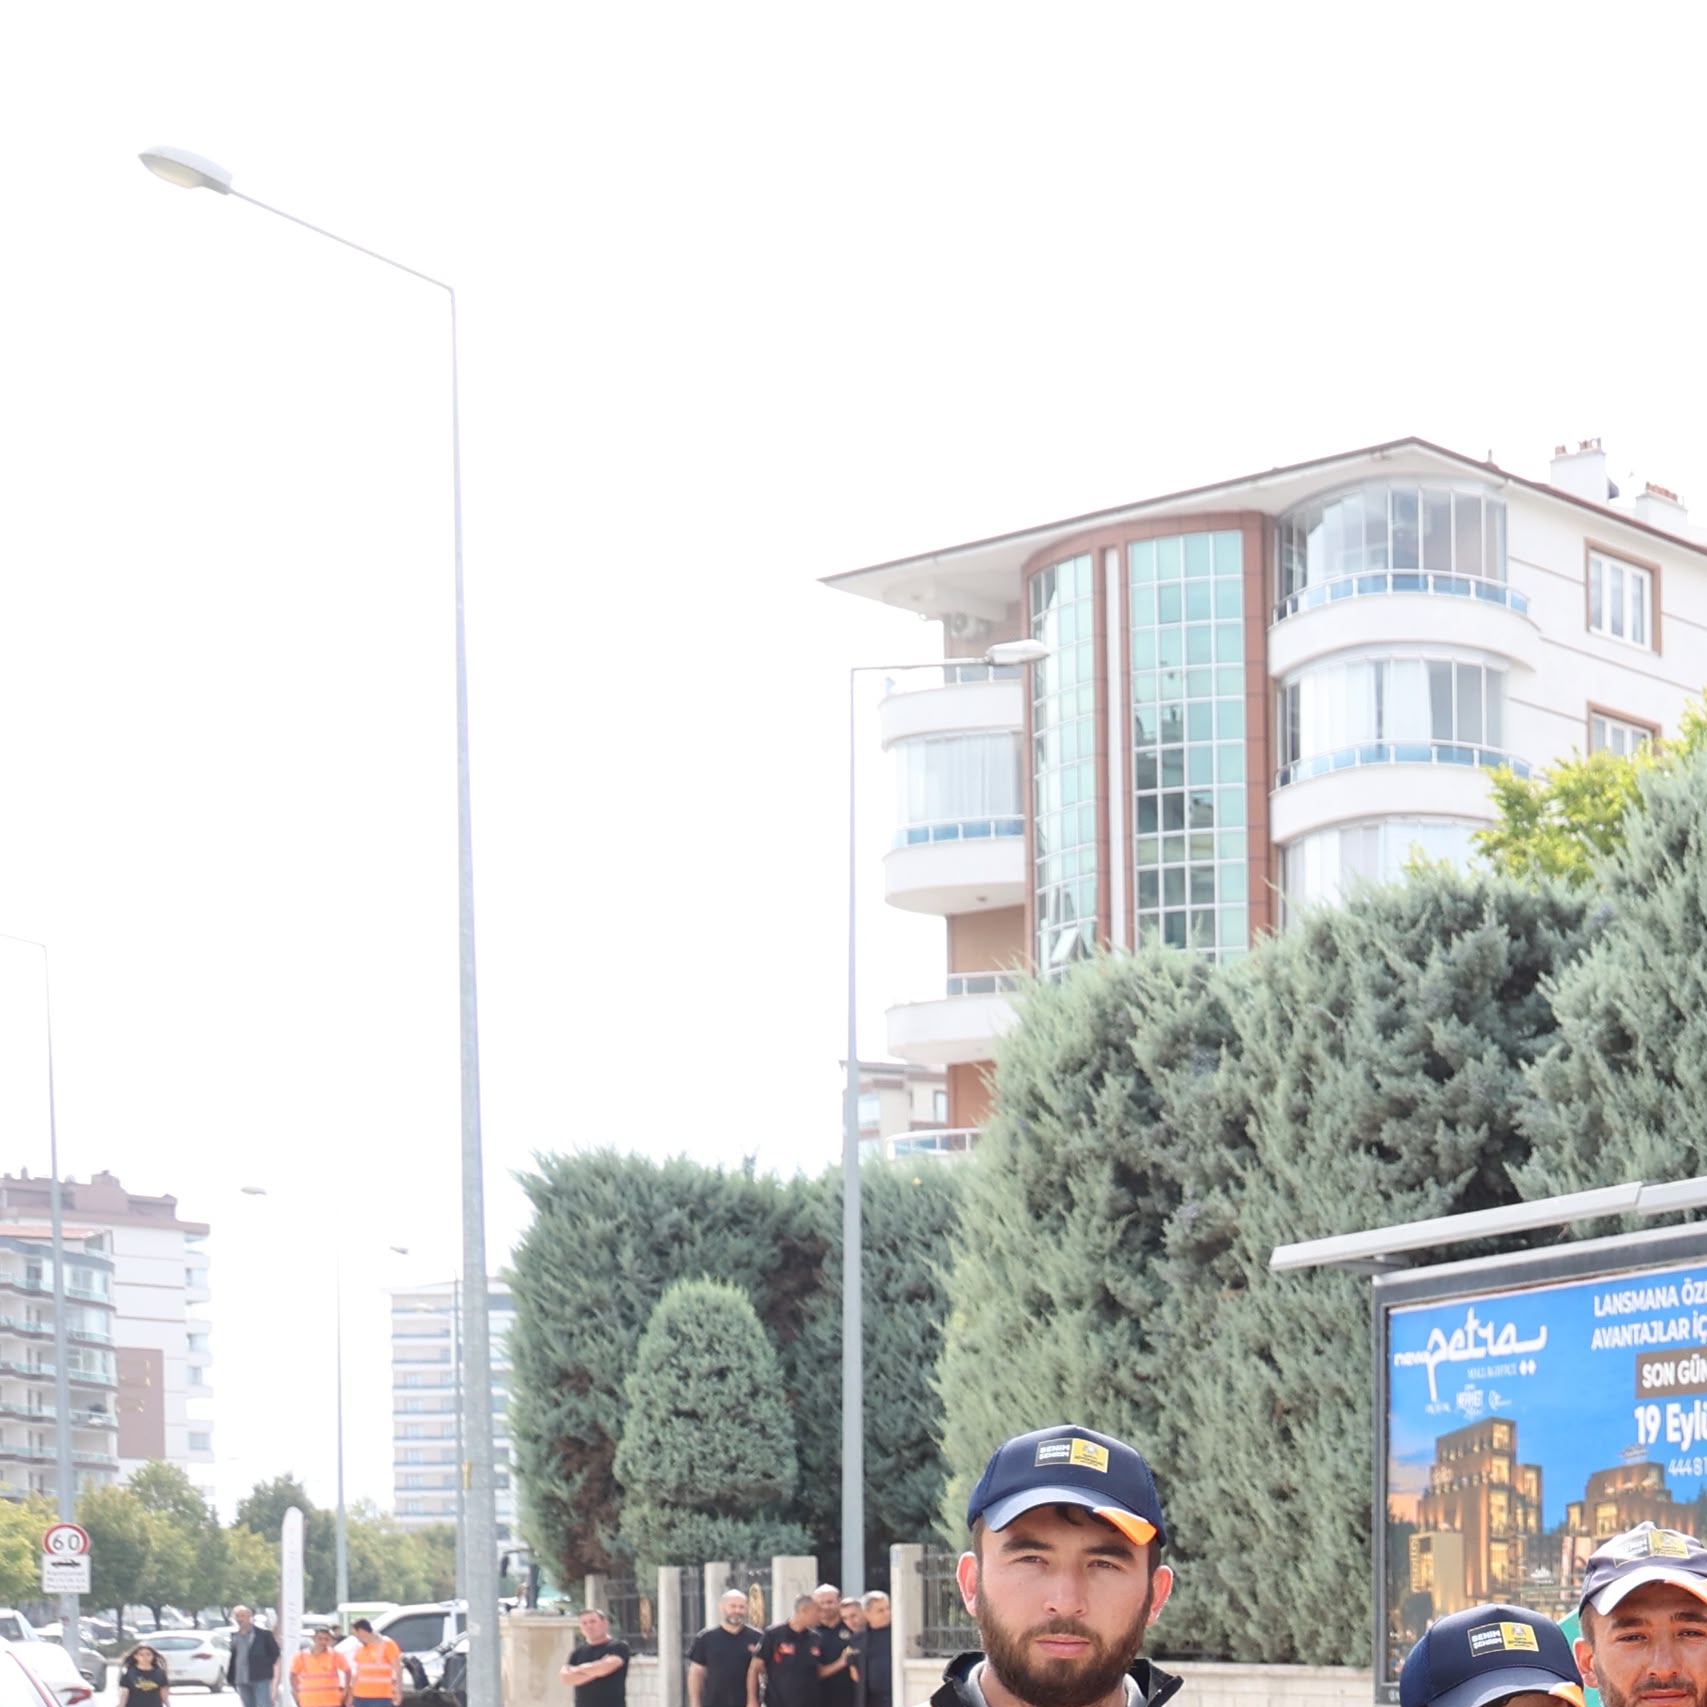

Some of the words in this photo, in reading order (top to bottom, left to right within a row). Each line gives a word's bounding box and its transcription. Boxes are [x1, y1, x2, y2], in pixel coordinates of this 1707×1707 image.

[1594, 1285, 1680, 1317] LANSMANA
[1591, 1317, 1690, 1350] AVANTAJLAR
[1642, 1361, 1675, 1389] SON
[1634, 1403, 1661, 1444] 19
[1668, 1458, 1693, 1476] 444
[53, 1534, 80, 1551] 60
